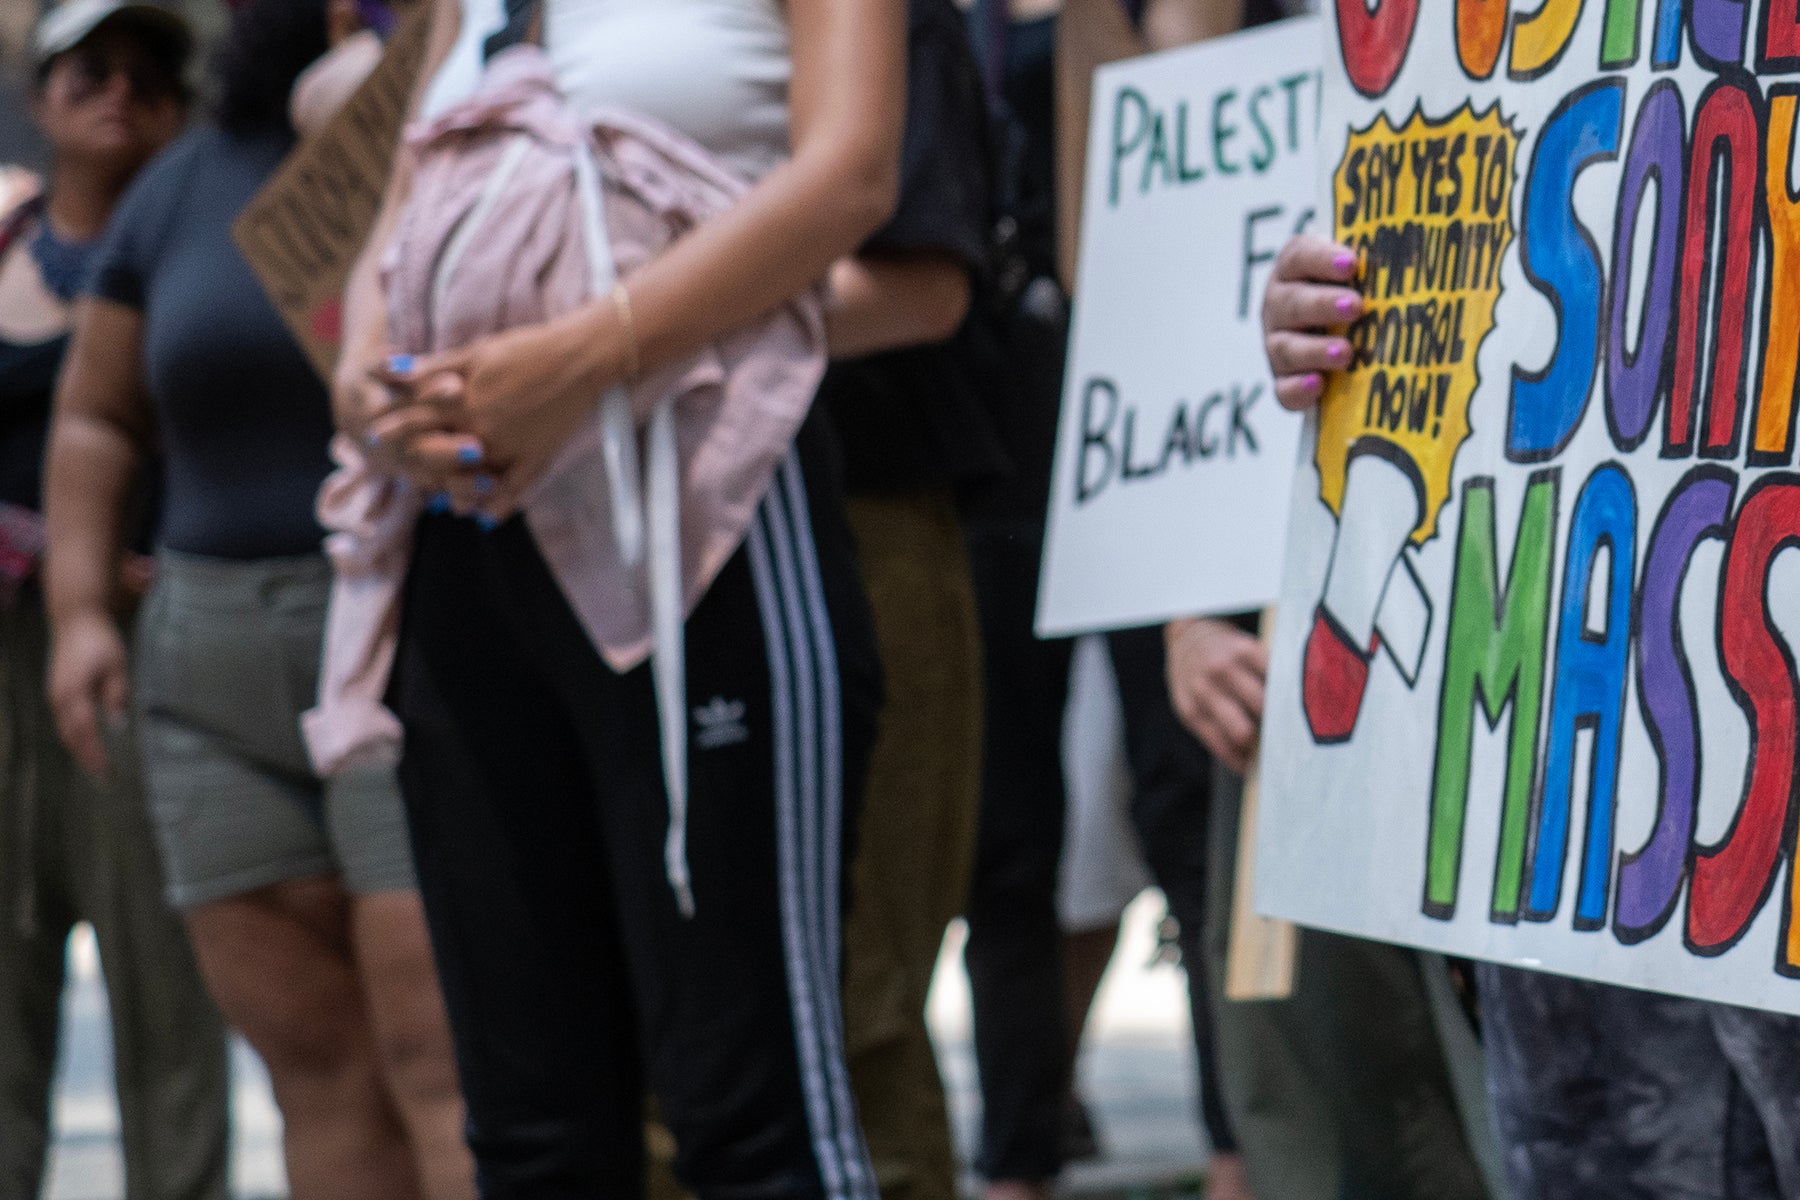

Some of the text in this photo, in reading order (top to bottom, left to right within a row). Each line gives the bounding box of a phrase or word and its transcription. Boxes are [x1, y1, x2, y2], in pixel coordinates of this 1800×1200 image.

[1341, 131, 1508, 228] SAY YES TO
[1343, 219, 1507, 299] OMMUNITY
[1073, 375, 1265, 508] BLACK
[1364, 368, 1451, 440] NOW!
